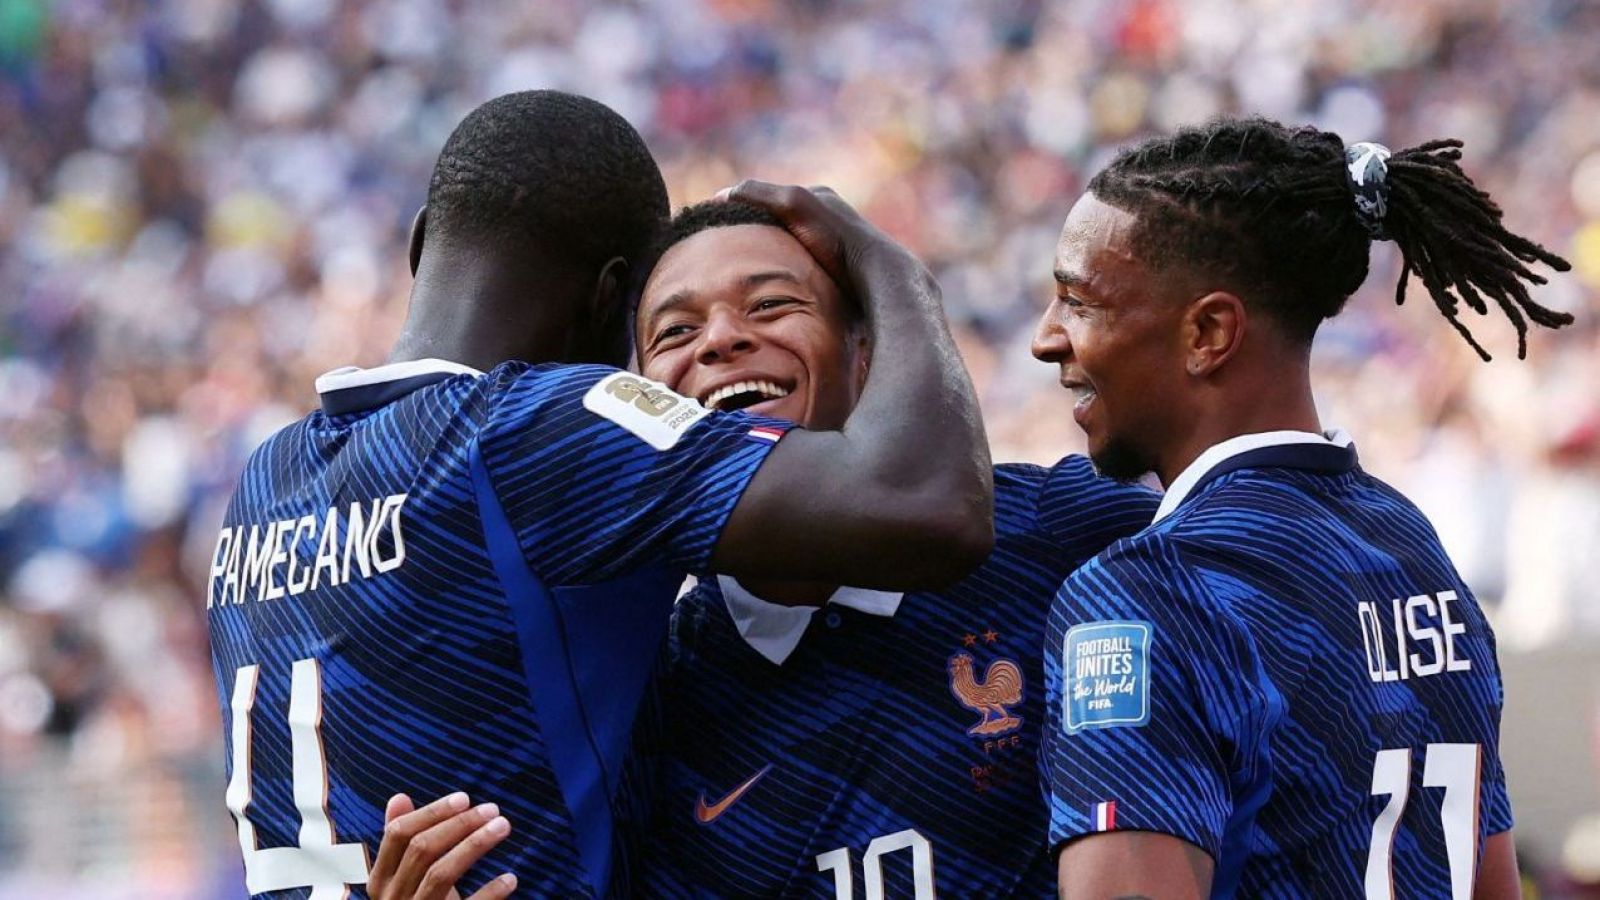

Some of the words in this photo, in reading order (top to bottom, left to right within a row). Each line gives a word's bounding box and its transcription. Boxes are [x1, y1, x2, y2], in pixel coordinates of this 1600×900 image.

[668, 407, 699, 430] 2026
[1076, 636, 1132, 657] FOOTBALL
[1357, 590, 1472, 683] OLISE
[1076, 653, 1132, 679] UNITES
[1073, 680, 1092, 701] the
[1094, 675, 1136, 697] World
[226, 657, 370, 900] 4
[1364, 743, 1482, 900] 11
